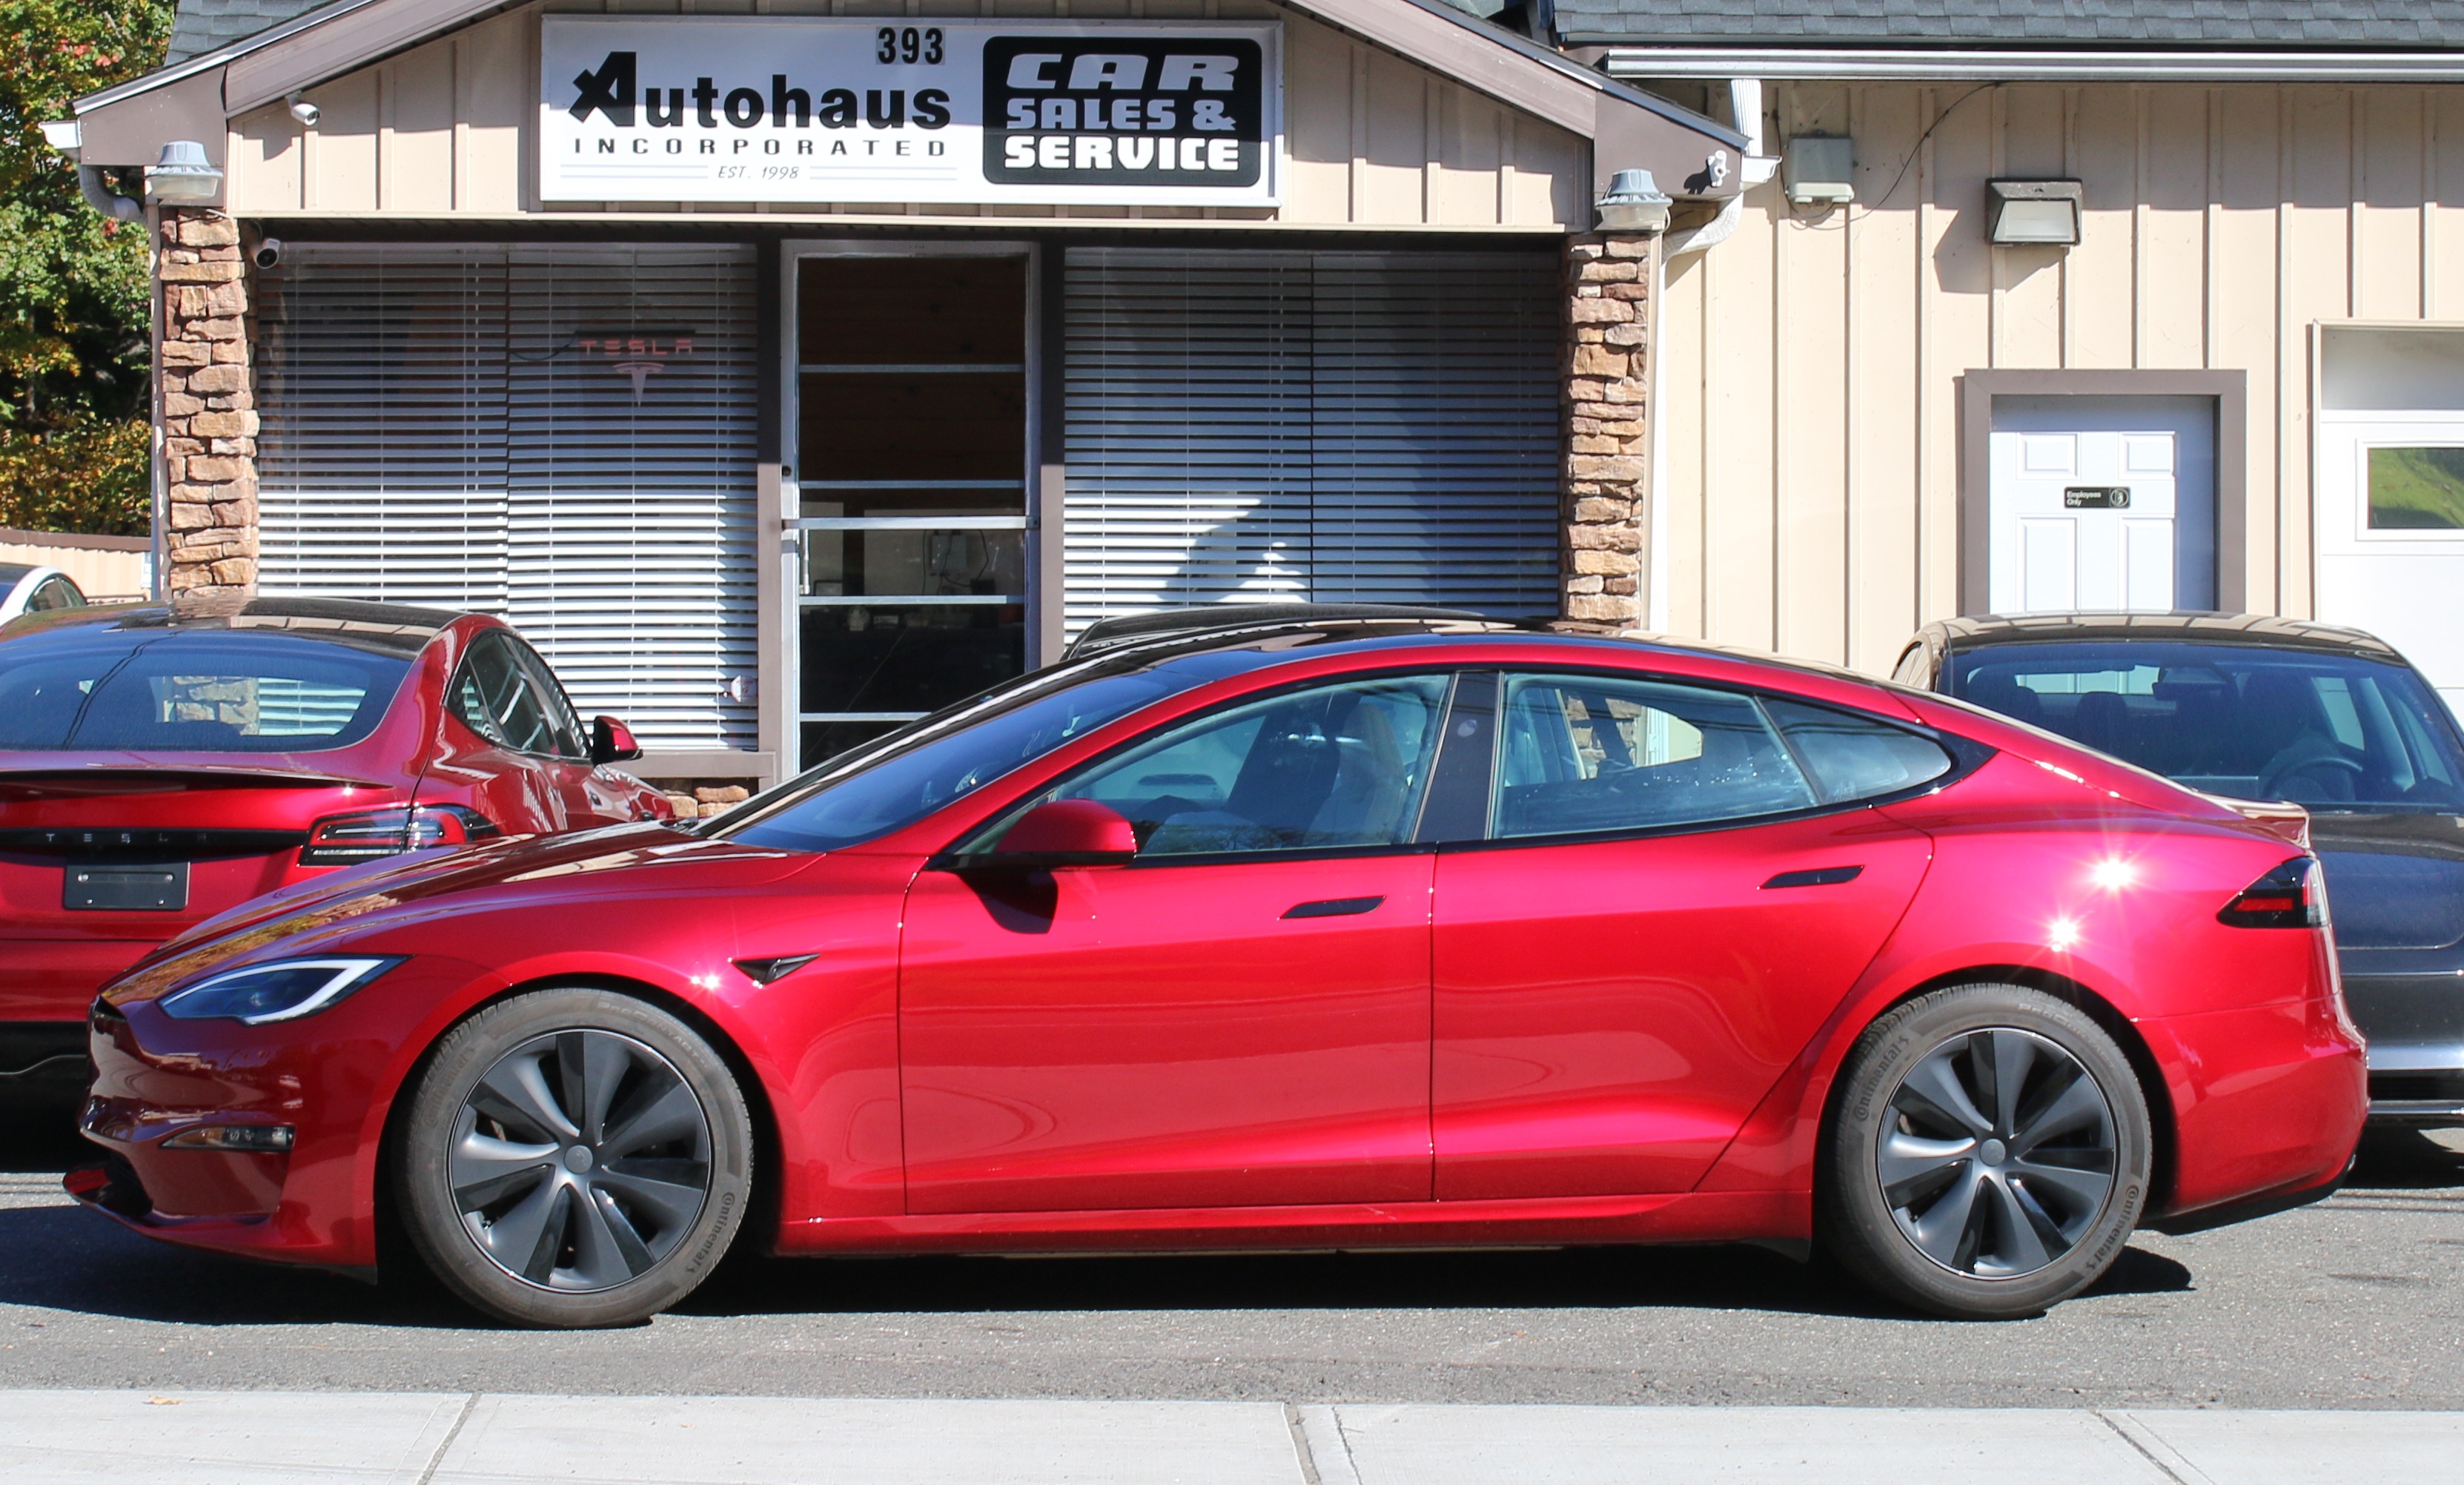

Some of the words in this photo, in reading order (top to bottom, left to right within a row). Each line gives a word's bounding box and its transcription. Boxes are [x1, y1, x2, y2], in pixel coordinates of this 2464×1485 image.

[878, 27, 943, 65] 393
[1006, 53, 1239, 90] CAR
[569, 51, 951, 130] Autohaus
[1007, 98, 1176, 130] SALES
[1192, 99, 1236, 131] &
[574, 138, 945, 156] INCORPORATED
[1004, 136, 1239, 171] SERVICE
[718, 165, 751, 179] EST.
[761, 166, 800, 180] 1998
[580, 339, 692, 356] TESLA
[2067, 491, 2102, 499] Employees
[2067, 498, 2082, 506] Only
[46, 833, 207, 844] TESLA
[1854, 1044, 1903, 1122] Continental
[693, 1191, 736, 1266] Continental
[2093, 1184, 2139, 1263] Continental
